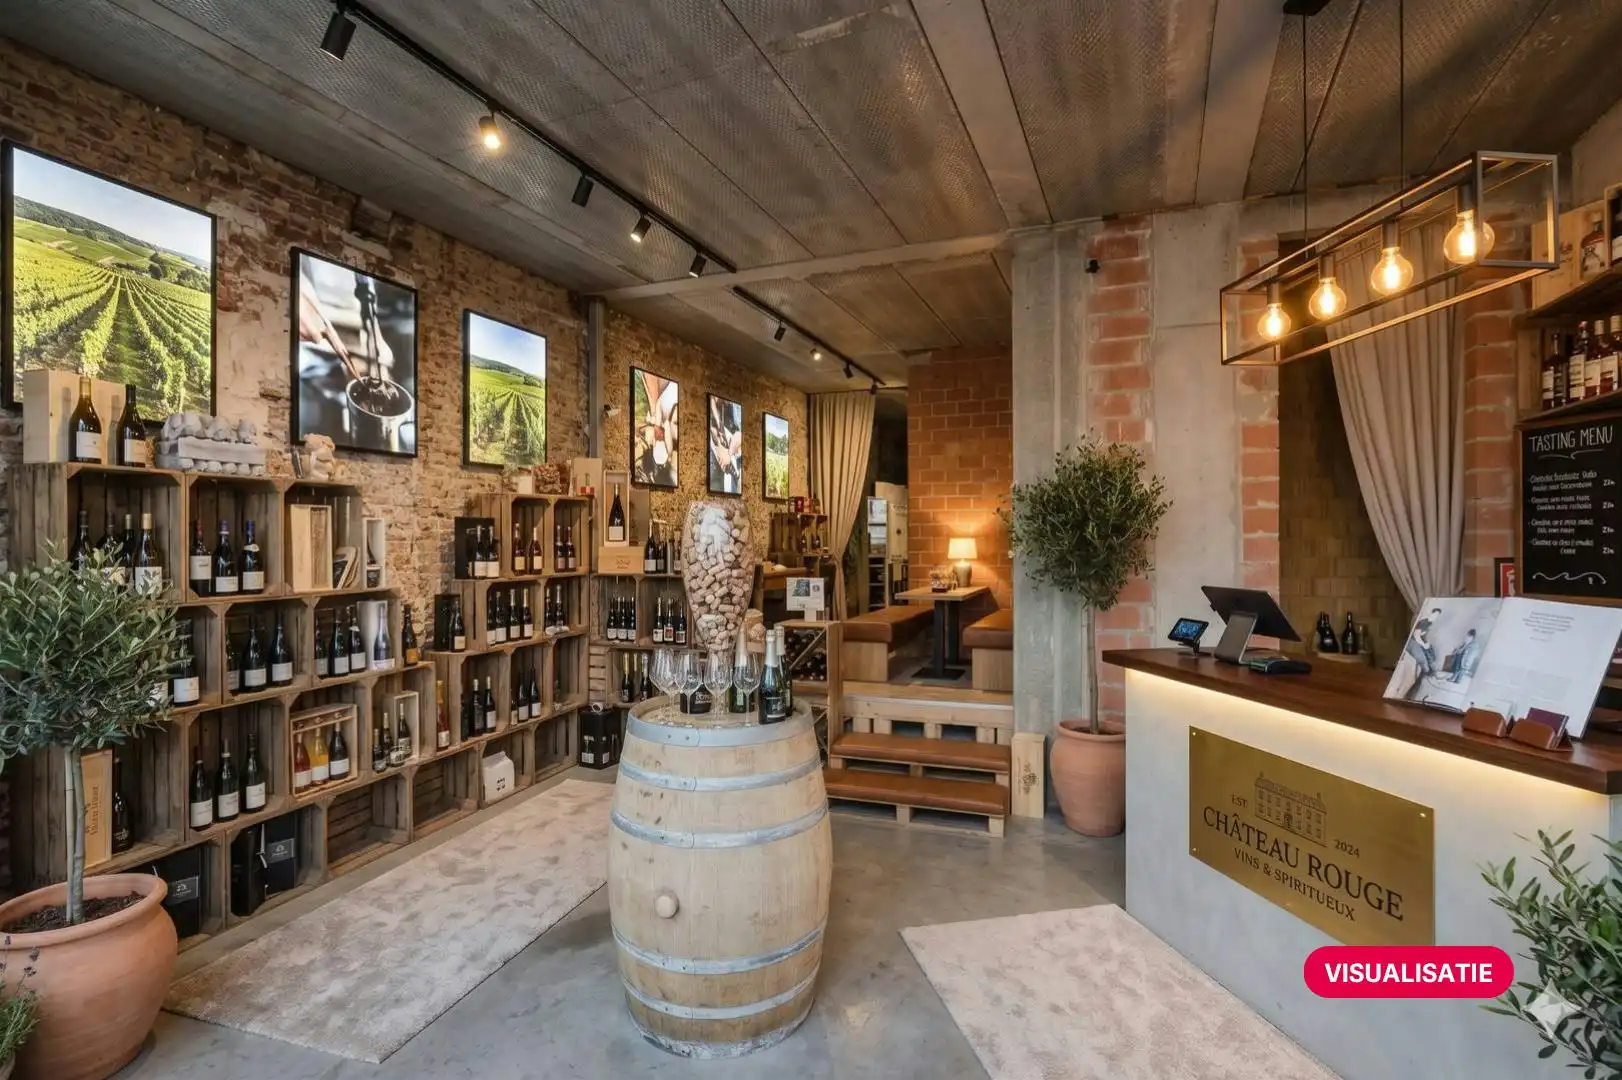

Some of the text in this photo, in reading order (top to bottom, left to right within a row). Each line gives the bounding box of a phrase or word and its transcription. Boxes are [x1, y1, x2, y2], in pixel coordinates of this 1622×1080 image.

[1528, 425, 1614, 453] TASTING MENU
[1203, 805, 1404, 922] CHÂTEAU ROUGE
[1234, 847, 1260, 870] VINS
[1263, 862, 1272, 877] &
[1333, 839, 1360, 859] 2024
